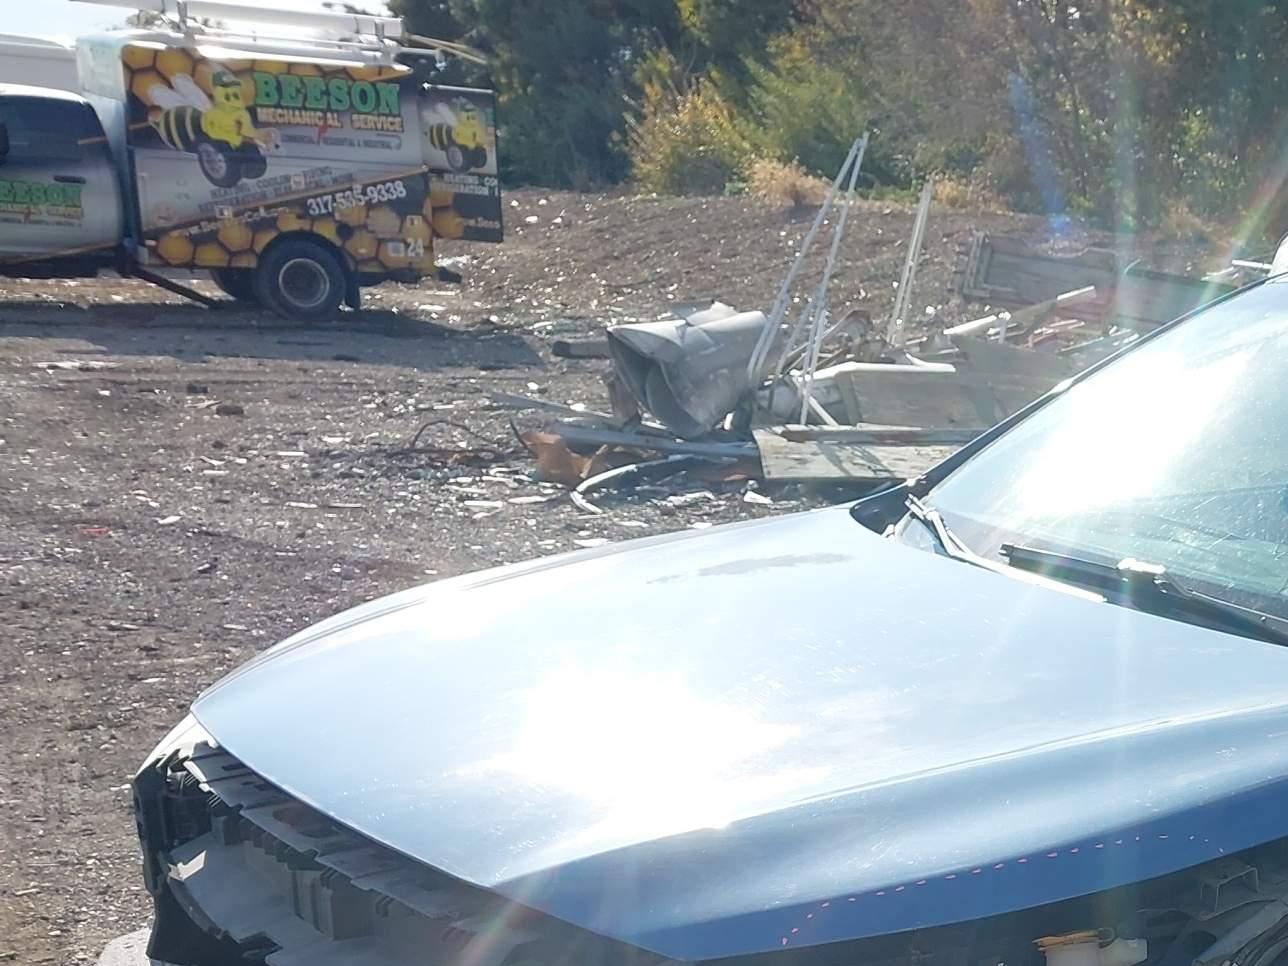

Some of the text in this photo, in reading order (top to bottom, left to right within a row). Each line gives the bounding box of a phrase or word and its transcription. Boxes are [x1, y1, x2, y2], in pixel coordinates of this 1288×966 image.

[253, 72, 401, 115] BEESON
[256, 107, 404, 132] MECHANICAL SERVICE
[306, 180, 407, 216] 317-535-9338
[408, 238, 424, 257] 24
